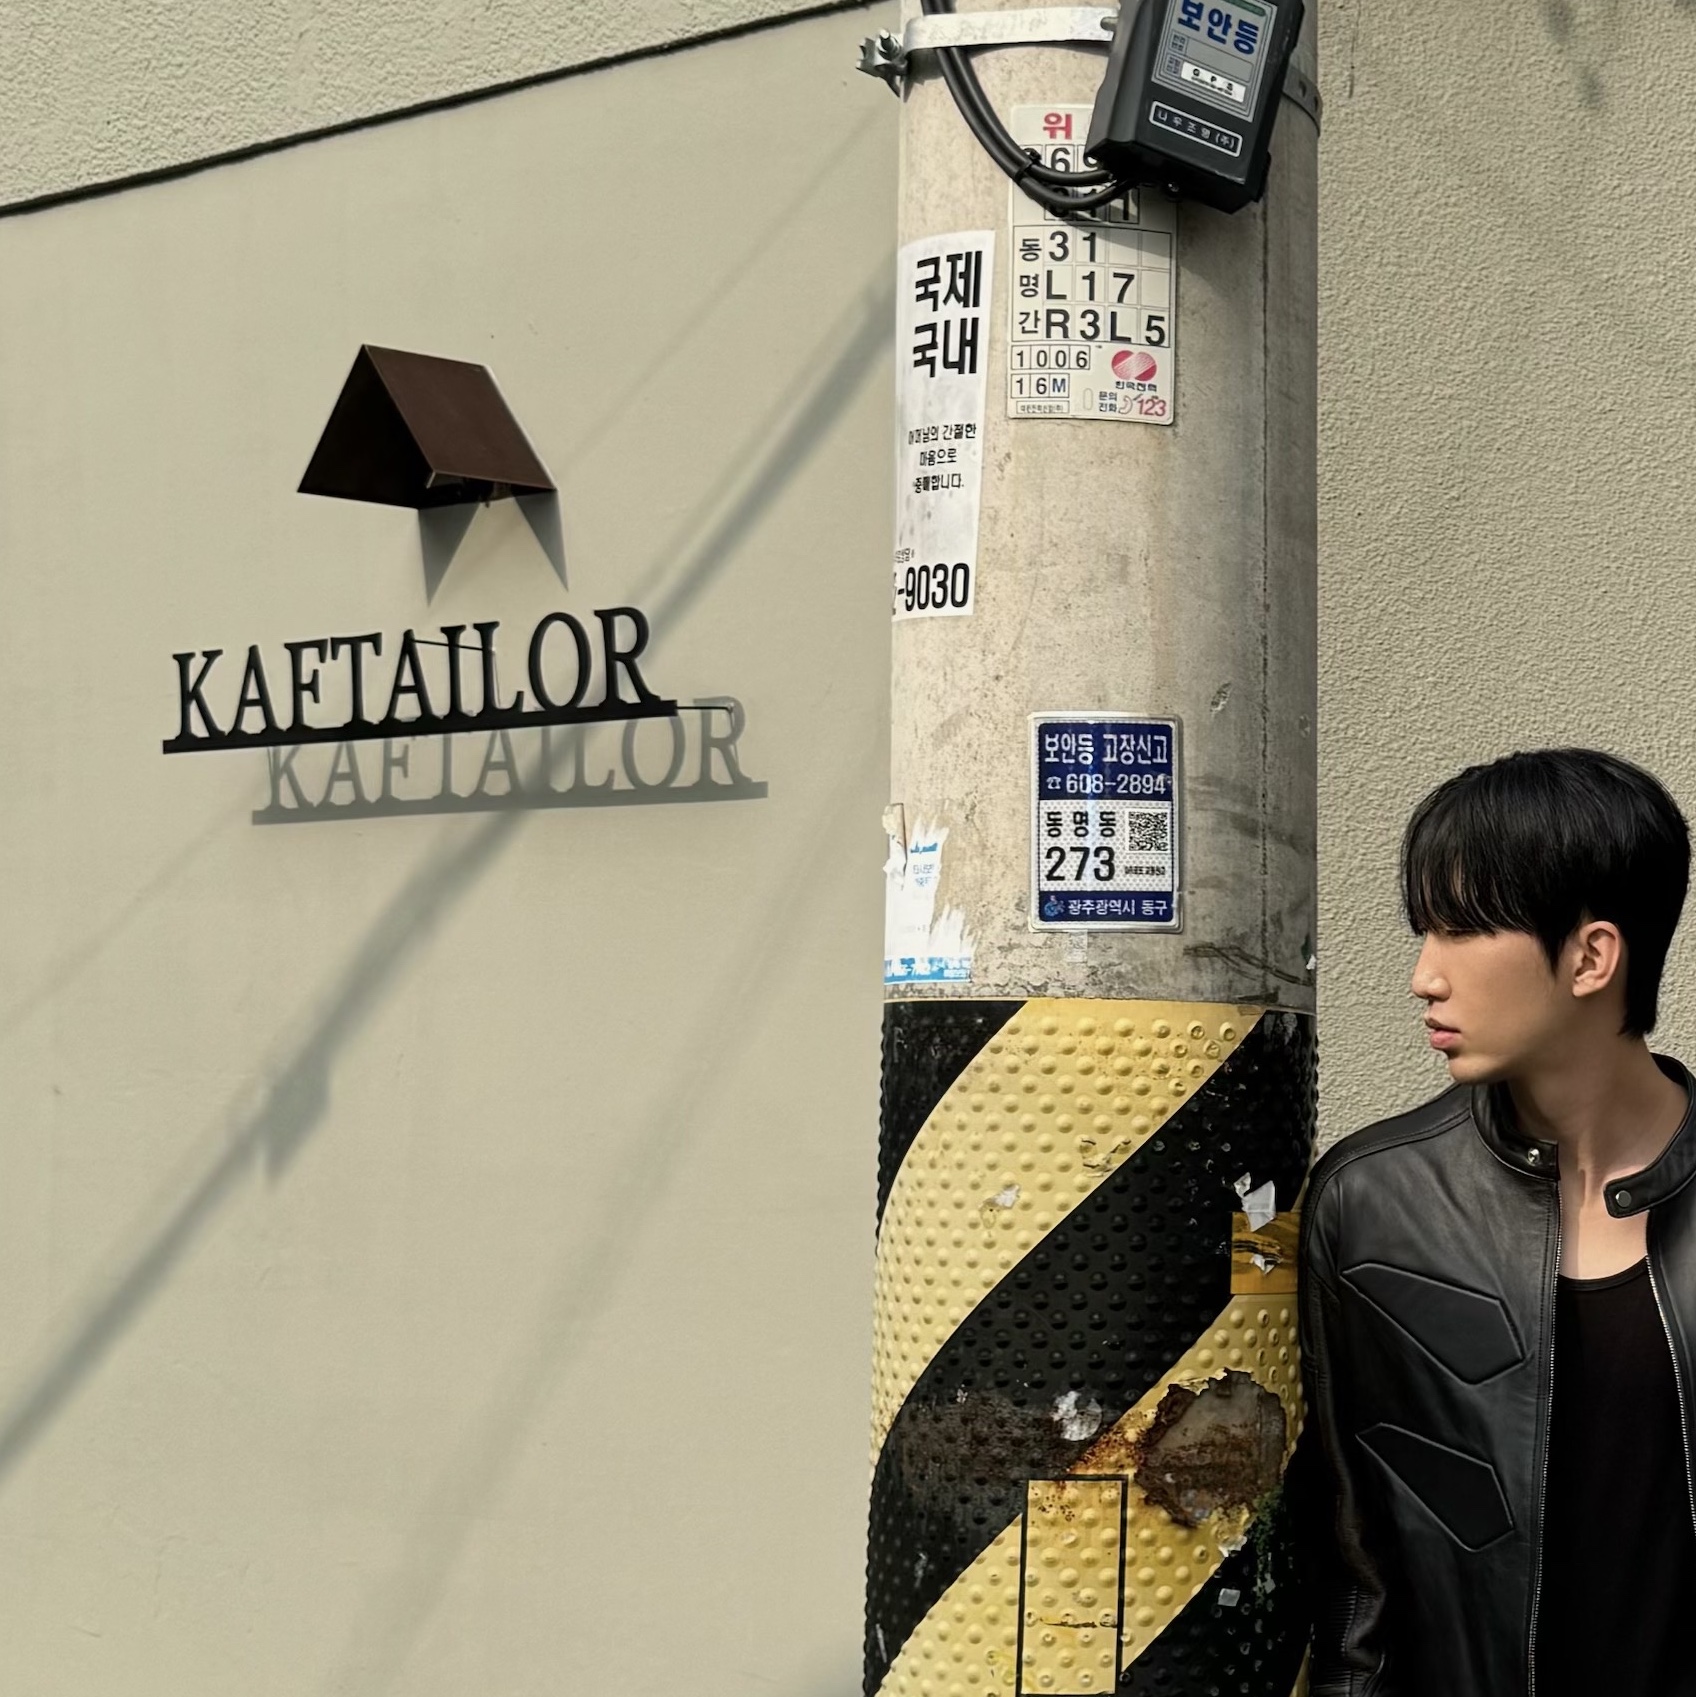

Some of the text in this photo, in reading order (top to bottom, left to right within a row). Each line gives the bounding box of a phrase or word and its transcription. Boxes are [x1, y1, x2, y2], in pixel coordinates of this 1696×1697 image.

[1178, 0, 1260, 55] 보안등
[1048, 230, 1097, 263] 31
[915, 250, 983, 312] 국제
[1045, 269, 1136, 304] L17
[1045, 308, 1167, 347] R3L5
[912, 317, 980, 379] 국내
[1017, 350, 1088, 368] 1006
[1016, 377, 1067, 395] 16M
[1136, 398, 1168, 417] 123
[942, 422, 978, 441] 간절한
[893, 562, 970, 612] -9030
[172, 606, 663, 742] KAFTAILOR
[1044, 732, 1168, 766] 보안등 고장신고
[1066, 773, 1167, 795] 608-2894
[1045, 810, 1117, 838] 동명동
[1044, 846, 1116, 882] 273
[1068, 899, 1168, 916] 광주광역시 동구
